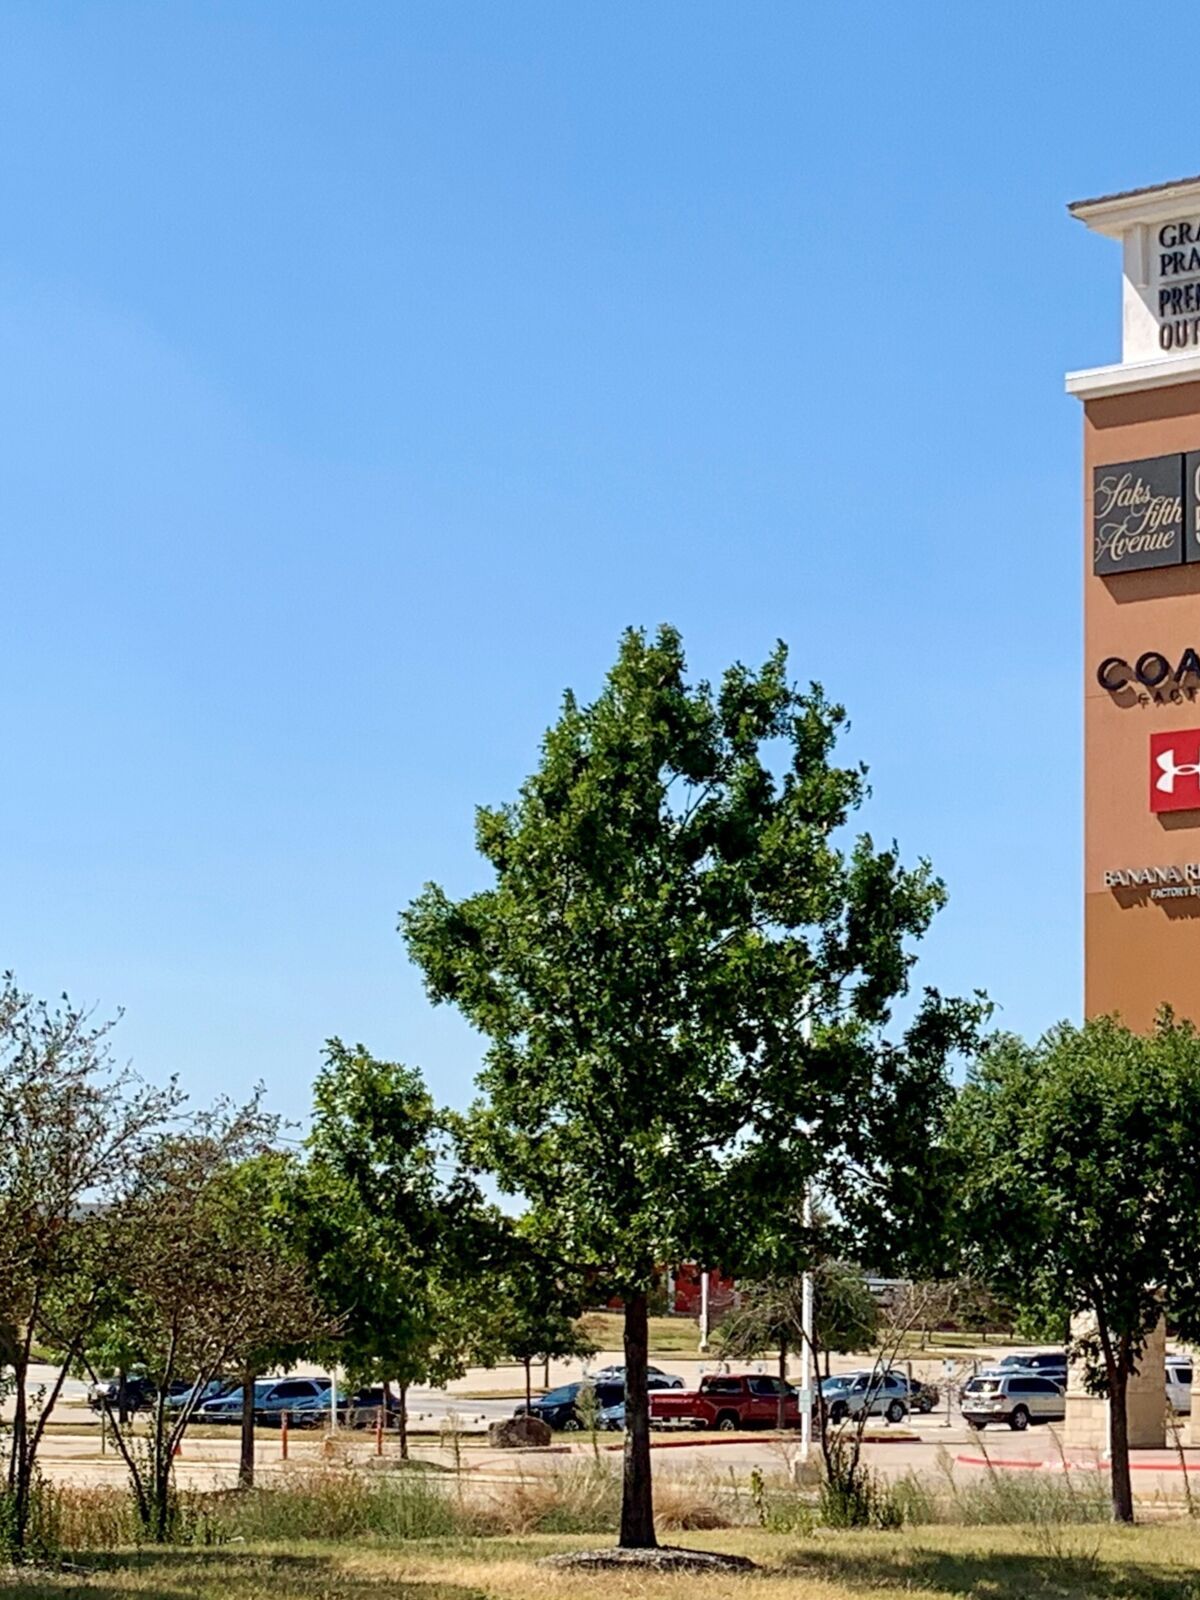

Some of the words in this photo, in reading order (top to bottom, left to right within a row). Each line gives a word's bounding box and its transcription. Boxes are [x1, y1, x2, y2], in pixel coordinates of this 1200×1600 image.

[1094, 472, 1151, 519] Saks
[1094, 523, 1175, 562] Avenue
[1104, 865, 1182, 887] BANANA
[1151, 886, 1188, 898] FACTORY
